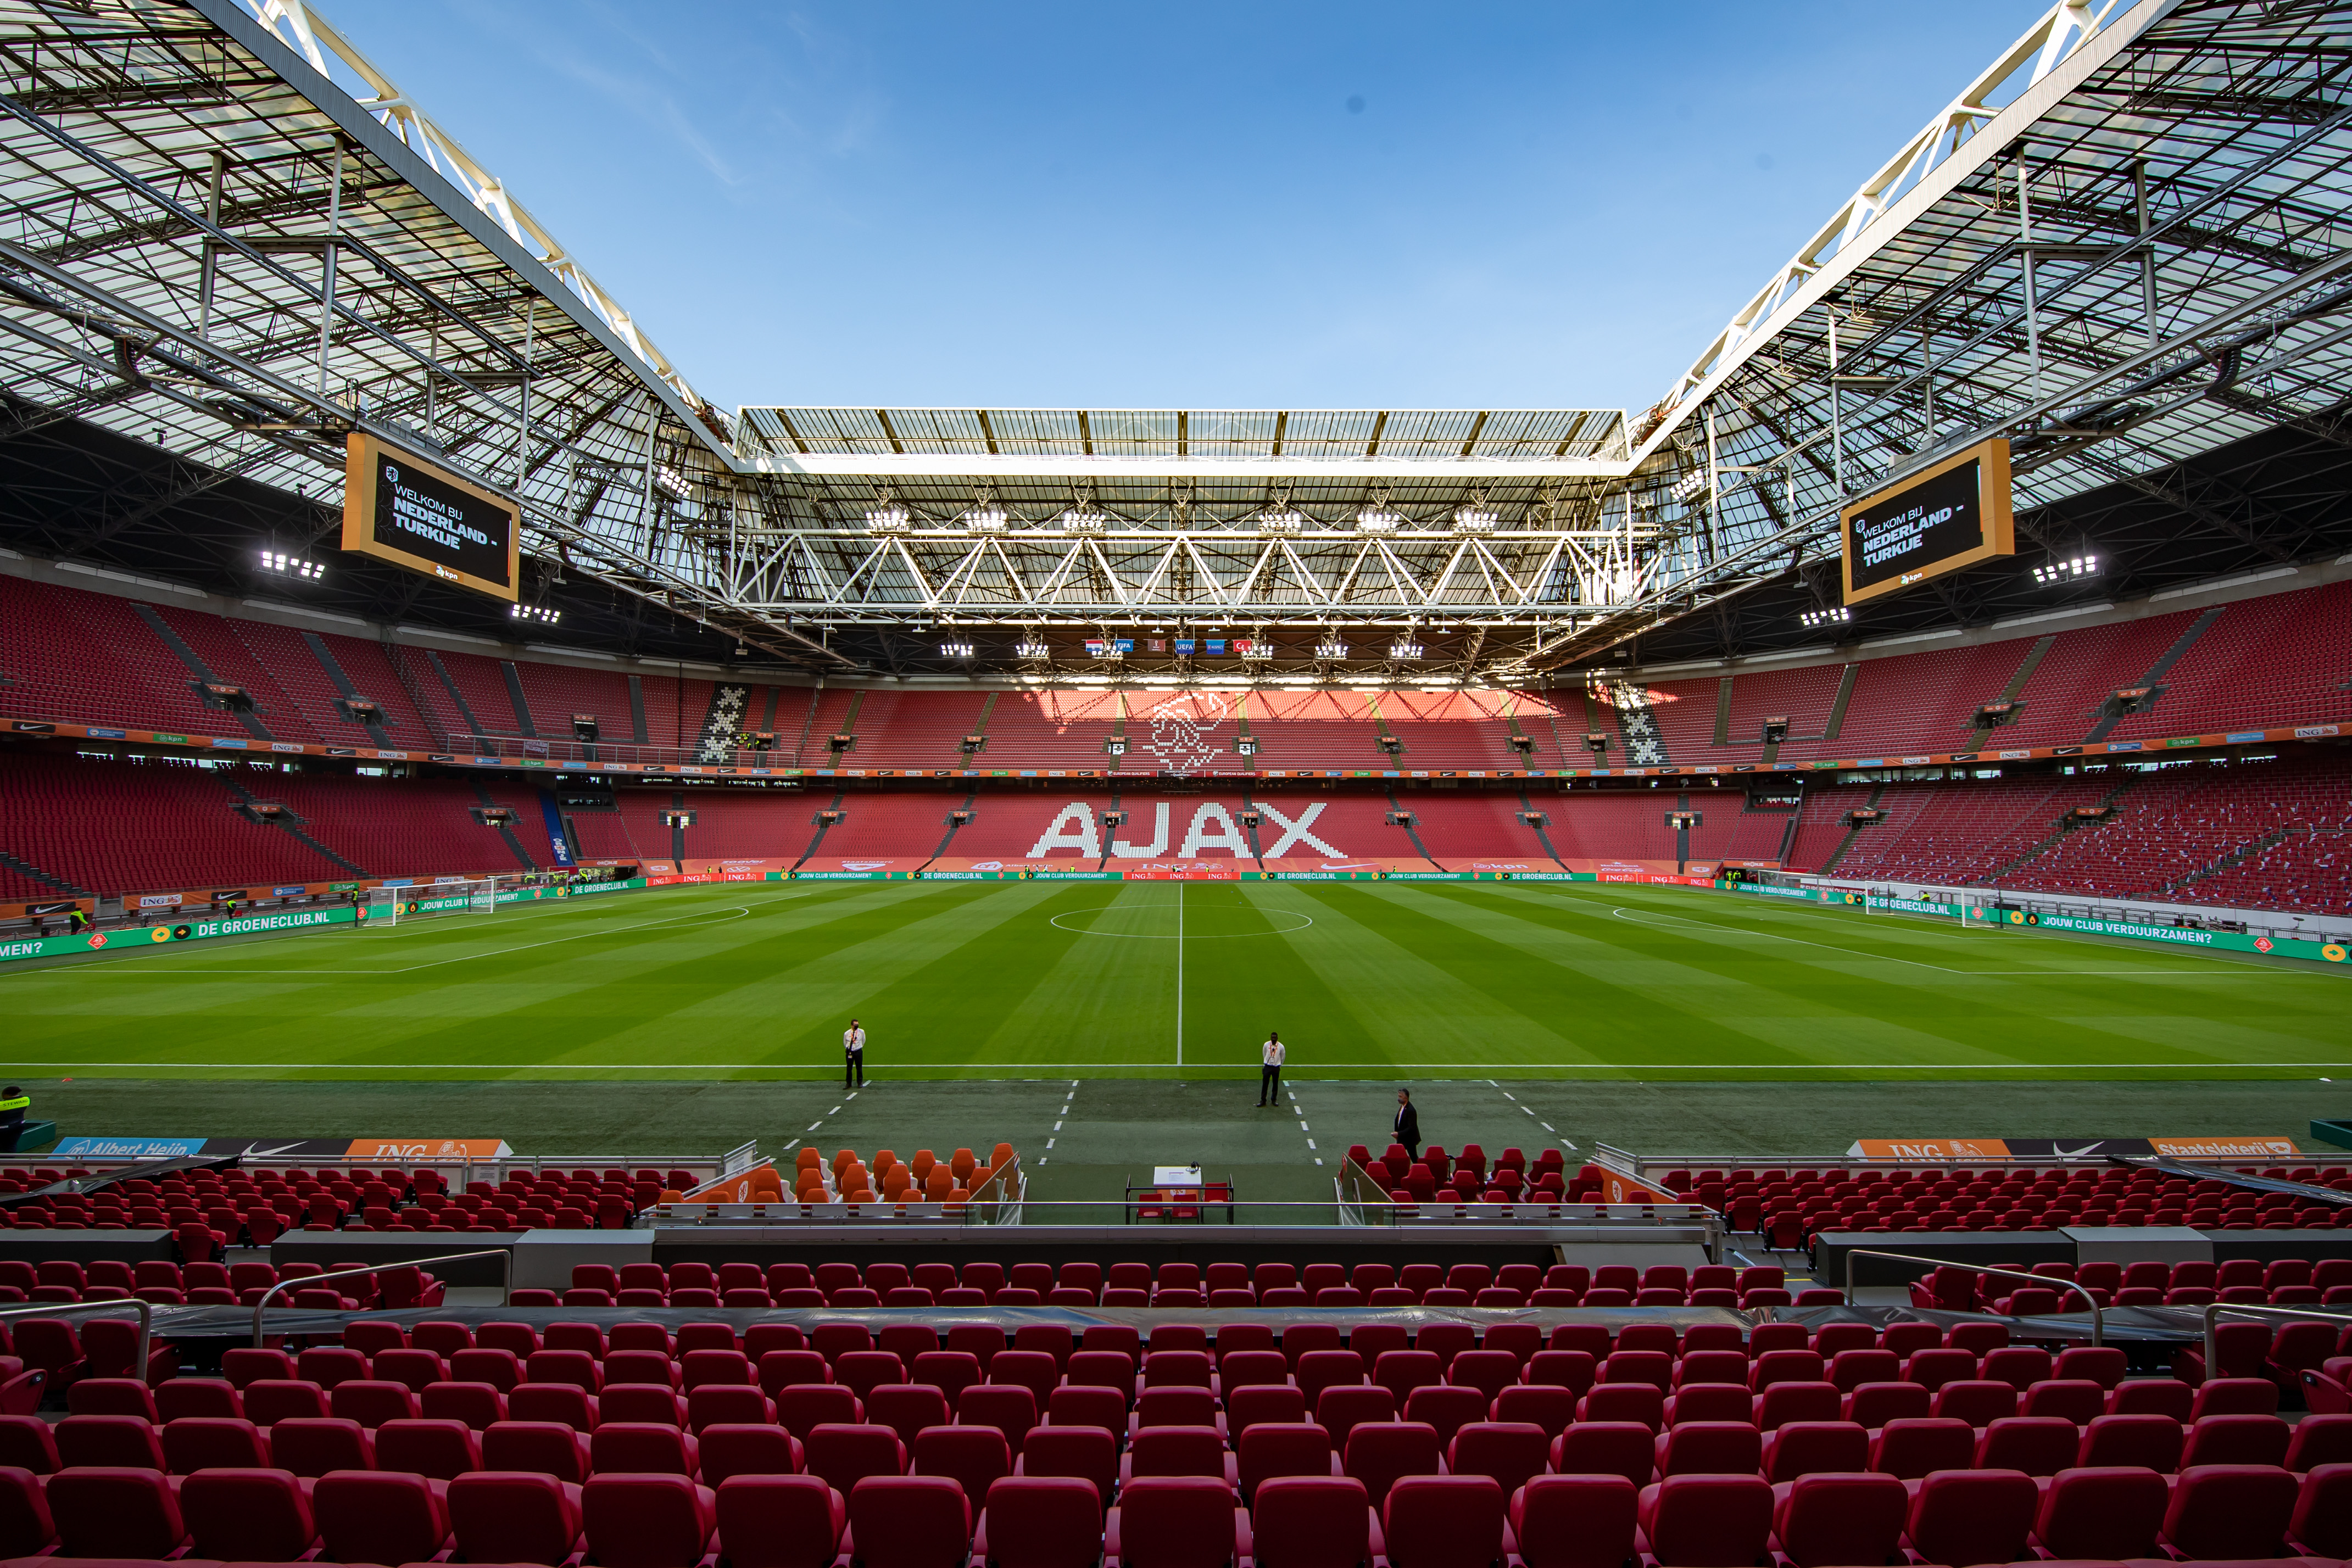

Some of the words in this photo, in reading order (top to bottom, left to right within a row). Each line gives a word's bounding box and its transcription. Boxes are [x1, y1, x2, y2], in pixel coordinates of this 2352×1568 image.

[394, 483, 445, 514] WELKOM
[448, 506, 462, 520] BIJ
[394, 496, 488, 545] NEDERLAND
[1863, 515, 1906, 539] WELKOM
[1908, 506, 1923, 520] BIJ
[393, 512, 460, 550] TURKIJE
[1863, 507, 1952, 554] NEDERLAND
[1863, 534, 1923, 566] TURKIJE
[445, 569, 458, 580] kpn
[1909, 572, 1922, 581] kpn
[1026, 802, 1348, 858] AJAX
[584, 881, 628, 892] GROENECLUB.NL
[421, 900, 443, 910] JOUW
[445, 898, 462, 907] CLUB
[1868, 897, 1877, 906] DE
[1879, 899, 1950, 914] GROENECLUB.NL
[198, 923, 218, 936] DE
[222, 912, 330, 933] GROENECLUB.NL
[2043, 916, 2073, 928] JOUW
[2076, 920, 2103, 931] CLUB
[2105, 923, 2212, 943] VERDUURZAMEN?
[3, 1099, 28, 1107] STEWARD
[90, 1142, 142, 1154] Albert
[372, 1145, 427, 1161] ING
[1888, 1145, 1946, 1162] ING
[2158, 1142, 2271, 1159] Staatsloterij
